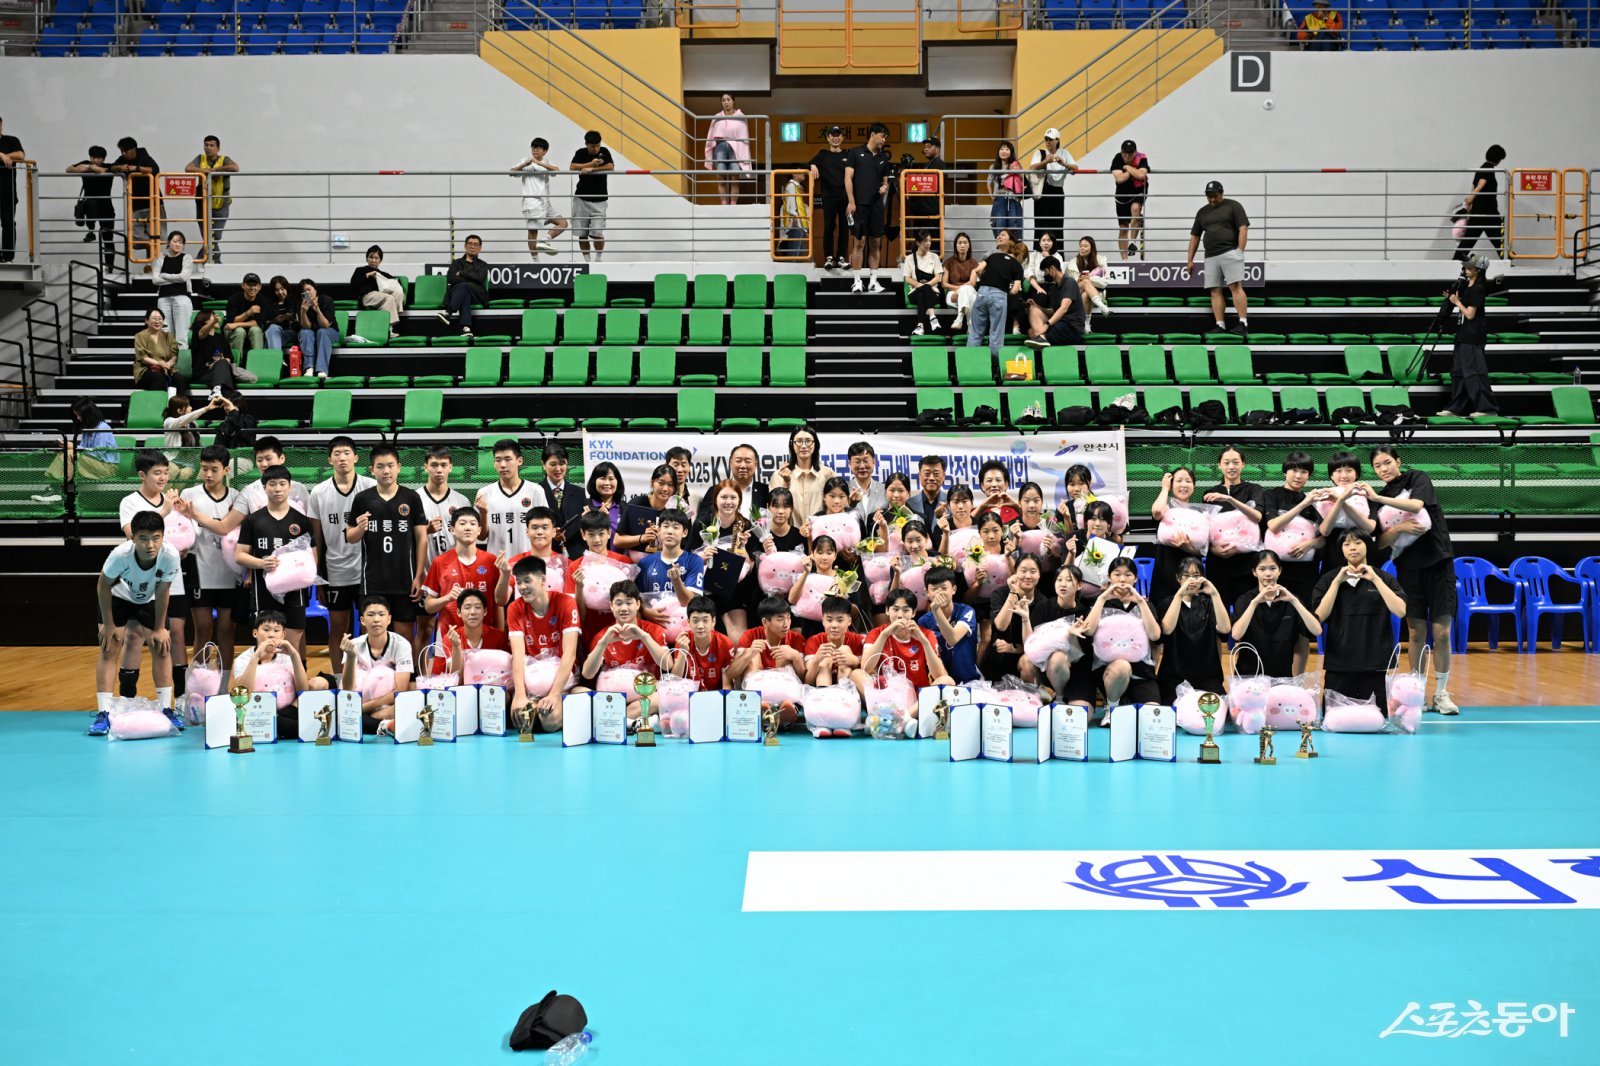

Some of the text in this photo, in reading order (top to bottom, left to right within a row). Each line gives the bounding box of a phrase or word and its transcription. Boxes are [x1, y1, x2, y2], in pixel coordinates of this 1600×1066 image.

[1238, 55, 1265, 88] D
[487, 267, 583, 285] 001~0075
[589, 440, 614, 449] KYK
[1083, 442, 1119, 453] 안산시
[589, 451, 667, 462] FOUNDATION
[368, 519, 409, 533] 태릉중
[432, 535, 447, 552] 15
[507, 528, 514, 544] 1
[383, 537, 393, 554] 6
[695, 573, 703, 587] 6
[571, 609, 578, 624] 8
[964, 608, 974, 623] 4
